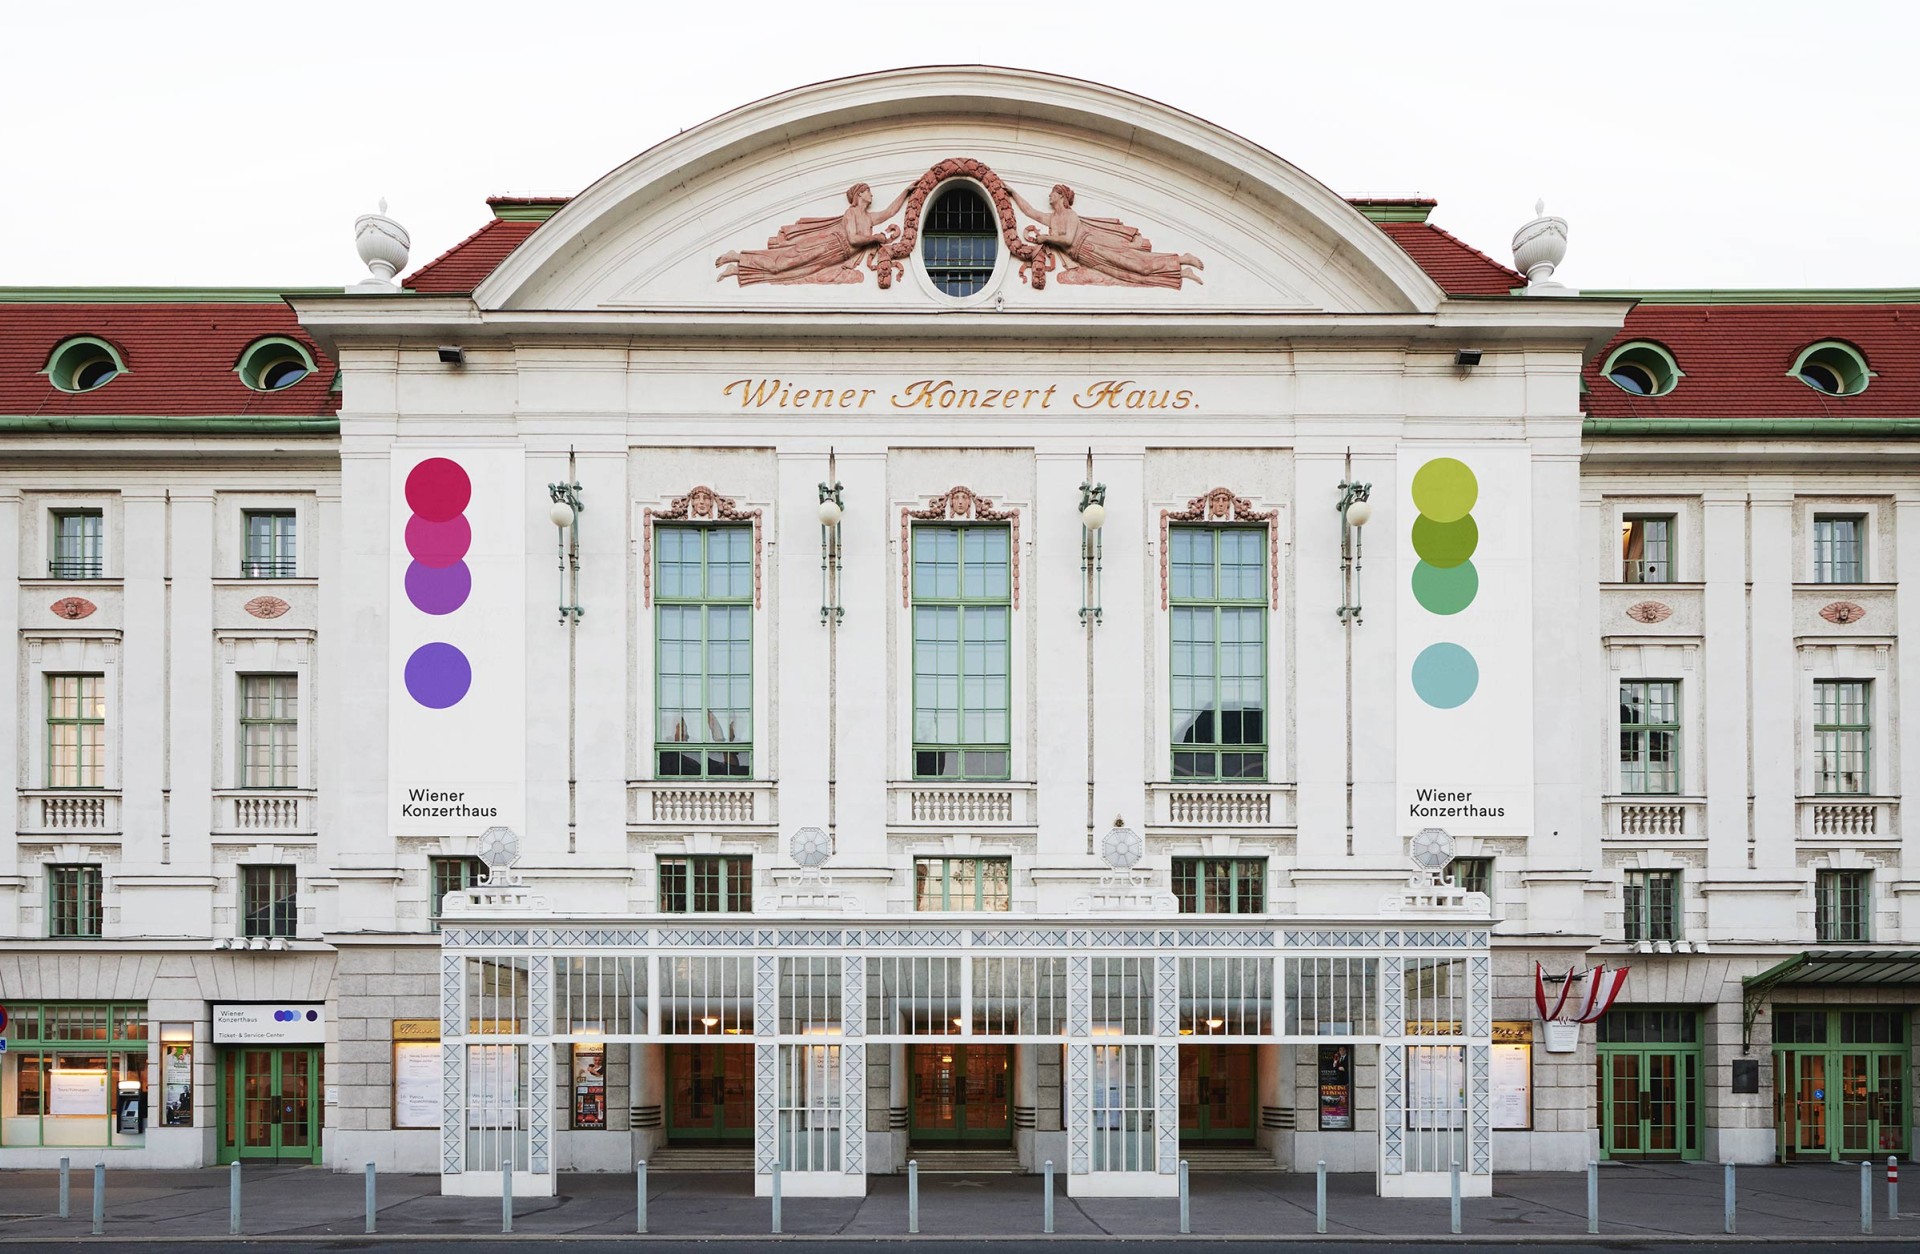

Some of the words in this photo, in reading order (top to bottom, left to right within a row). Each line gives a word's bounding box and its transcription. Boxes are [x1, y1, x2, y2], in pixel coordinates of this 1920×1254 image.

[723, 379, 876, 409] Wiener
[890, 379, 1056, 409] Konzert
[1072, 380, 1200, 409] Haus.
[409, 788, 464, 801] Wiener
[1416, 788, 1472, 801] Wiener
[402, 804, 497, 817] Konzerthaus
[1410, 804, 1504, 817] Konzerthaus
